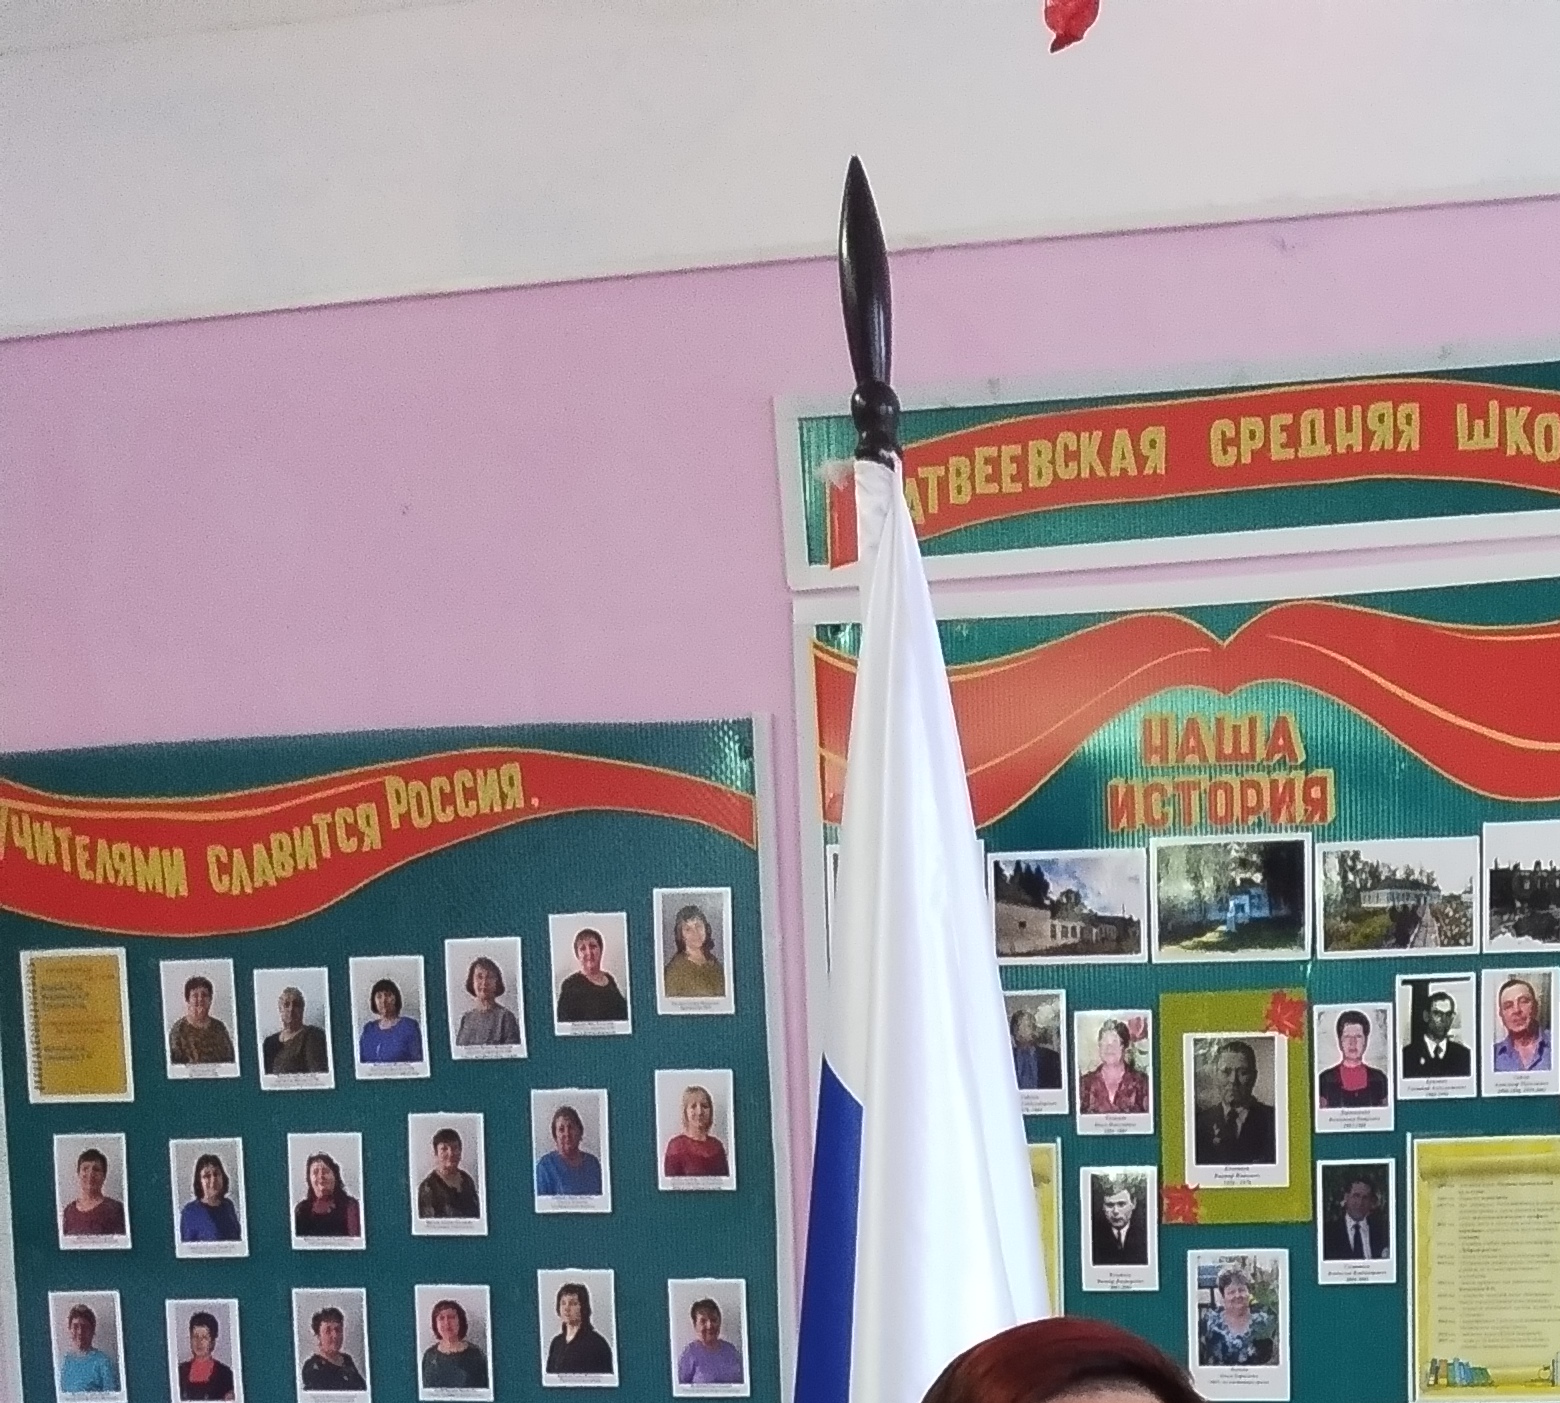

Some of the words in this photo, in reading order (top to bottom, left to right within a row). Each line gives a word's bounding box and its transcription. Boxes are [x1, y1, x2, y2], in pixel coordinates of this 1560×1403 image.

[903, 425, 1168, 526] АТВЕЕВСКАЯ
[1209, 400, 1421, 468] СРЕДНЯЯ
[1142, 711, 1307, 767] НАША
[1107, 768, 1338, 832] ИСТОРИЯ
[206, 802, 383, 896] СЛАВИТСЯ
